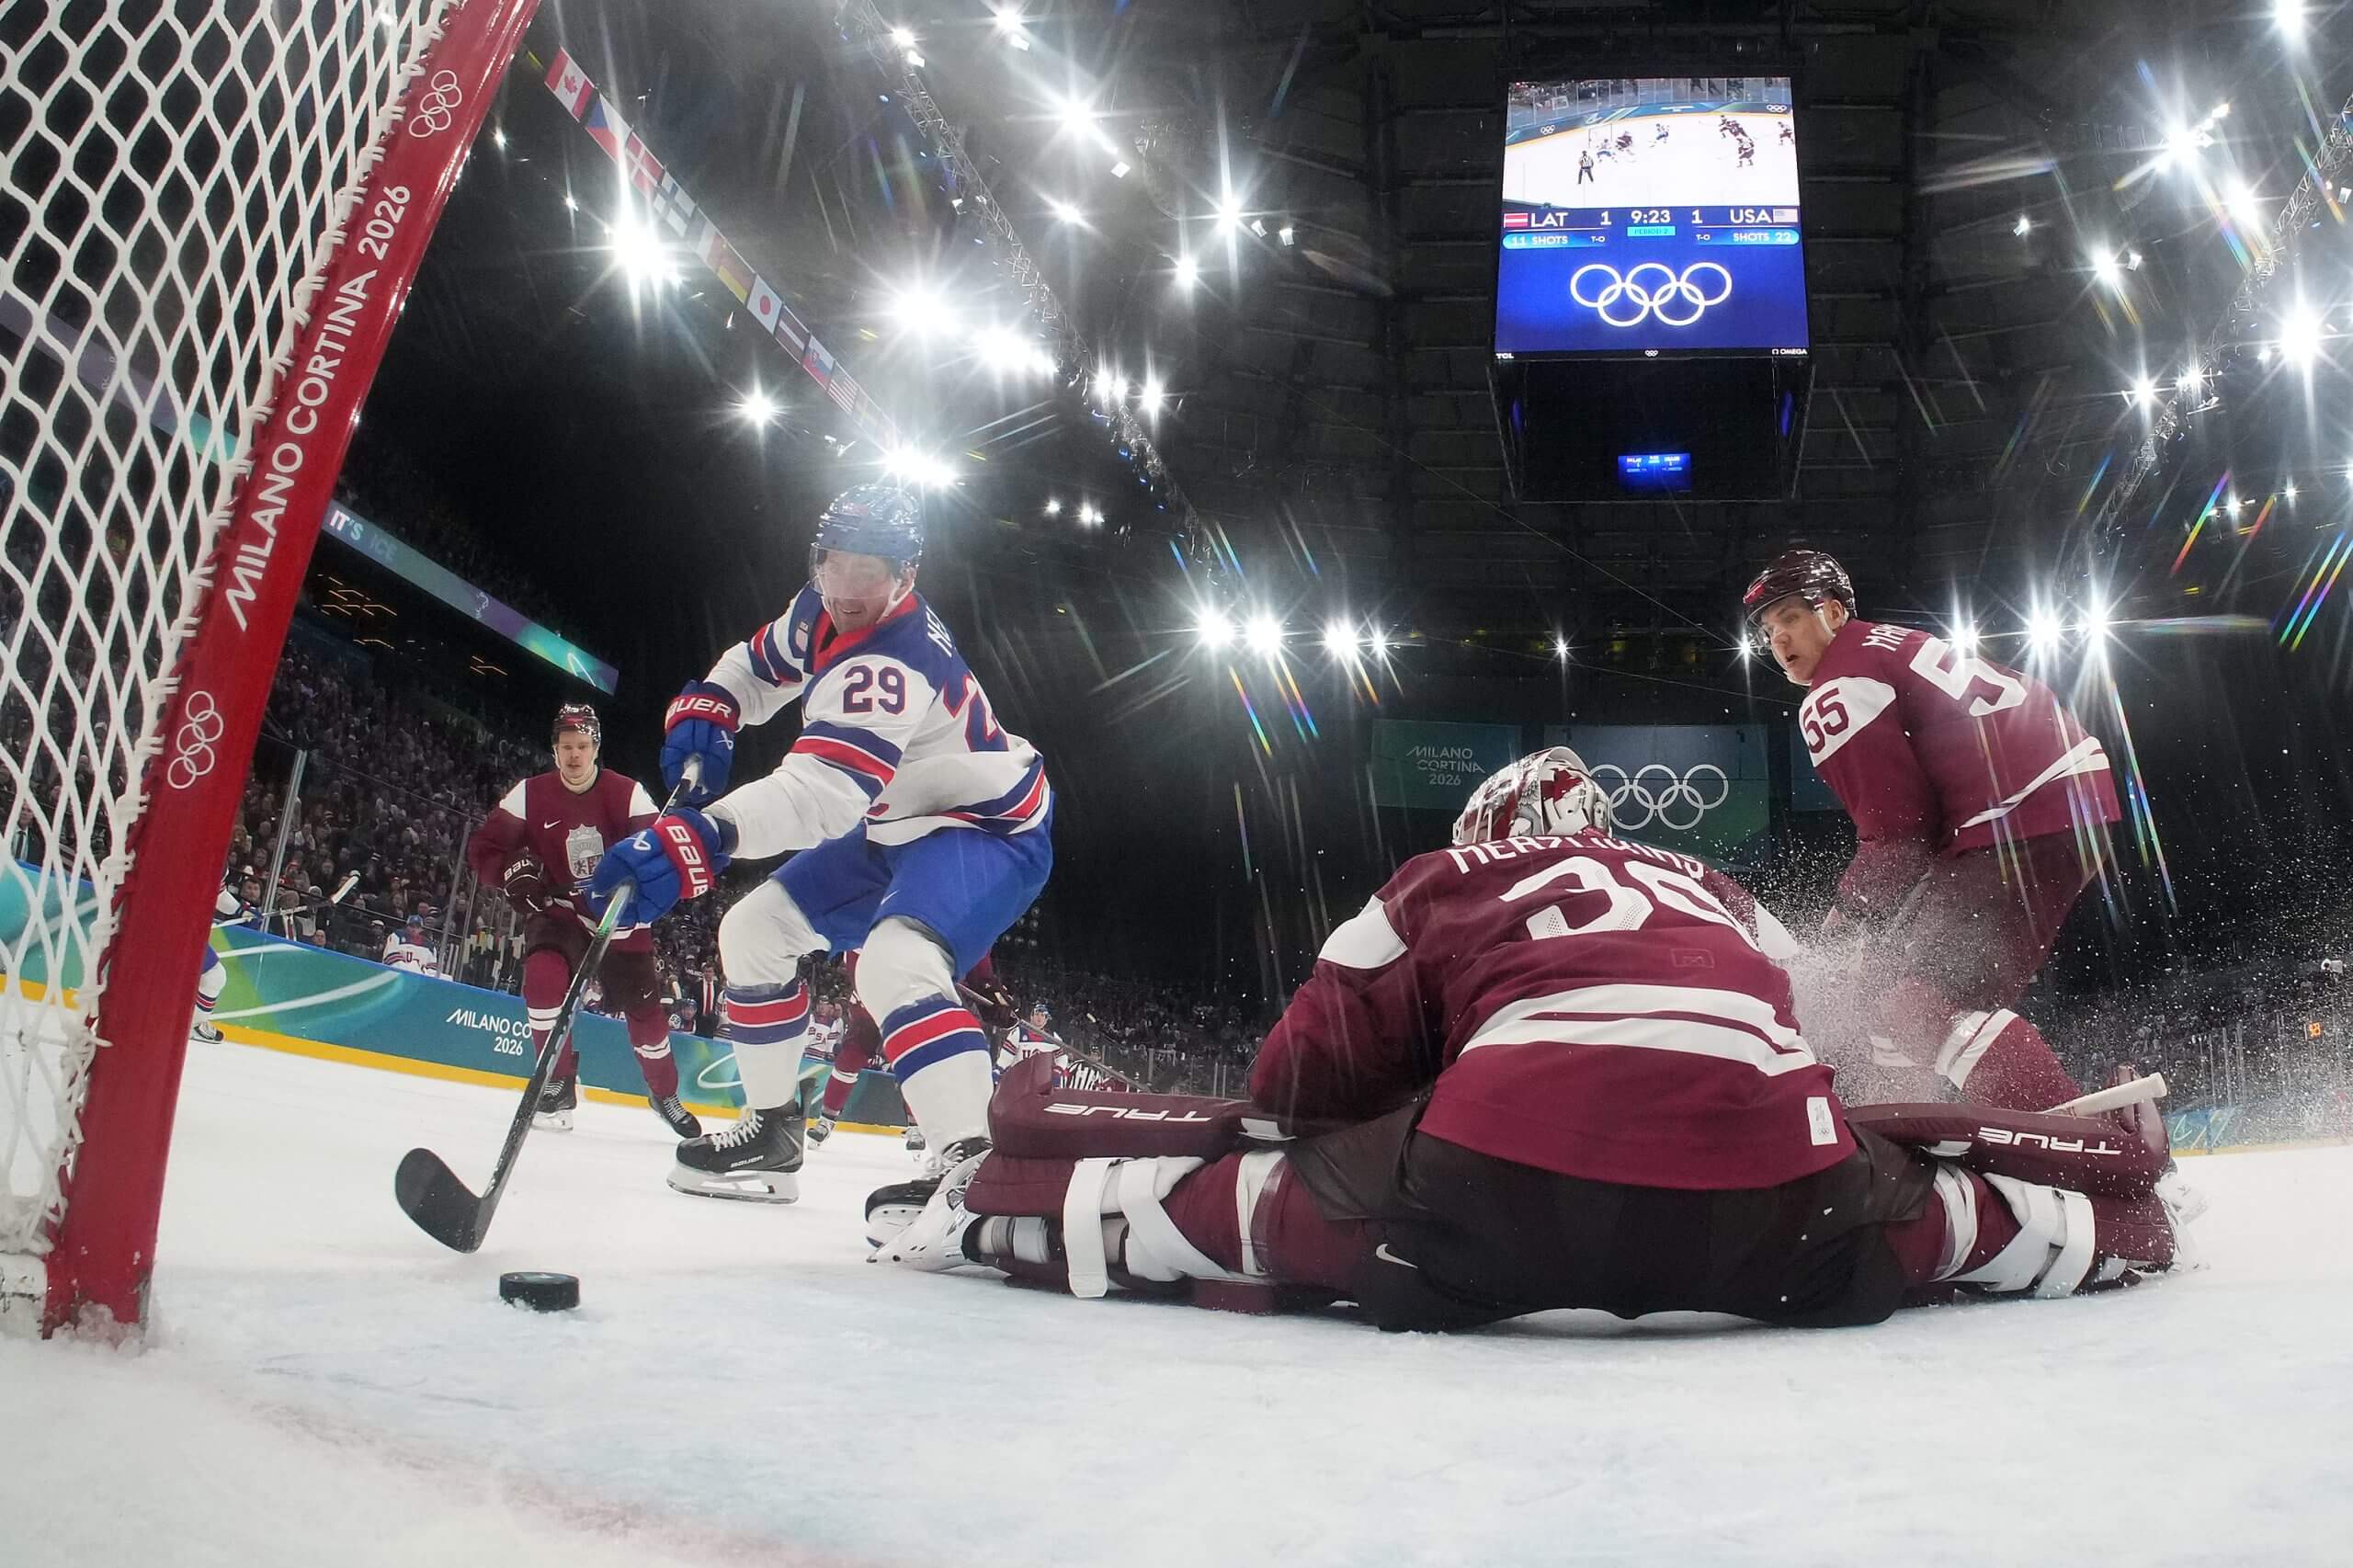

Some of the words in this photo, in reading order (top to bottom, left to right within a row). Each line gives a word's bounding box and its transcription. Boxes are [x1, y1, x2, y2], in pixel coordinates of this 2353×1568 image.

[1530, 212, 1568, 228] LAT
[1600, 210, 1611, 225] 1
[1631, 210, 1671, 224] 9:23
[1691, 210, 1702, 223] 1
[1730, 209, 1772, 223] USA
[1531, 235, 1568, 245] SHOTS
[1733, 233, 1769, 243] SHOTS
[226, 443, 303, 632] MILANO
[286, 269, 379, 435] CORTINA
[358, 186, 411, 260] 2026
[329, 509, 364, 540] IT'S
[843, 664, 907, 716] 29
[1803, 687, 1849, 754] 55
[1405, 745, 1473, 759] MILANO
[1416, 759, 1486, 774] CORTINA
[1429, 774, 1461, 786] 2026
[446, 1007, 510, 1035] MILANO
[494, 1037, 523, 1056] 2026
[1043, 1103, 1212, 1122] TRUE
[1977, 1126, 2122, 1155] TRUE
